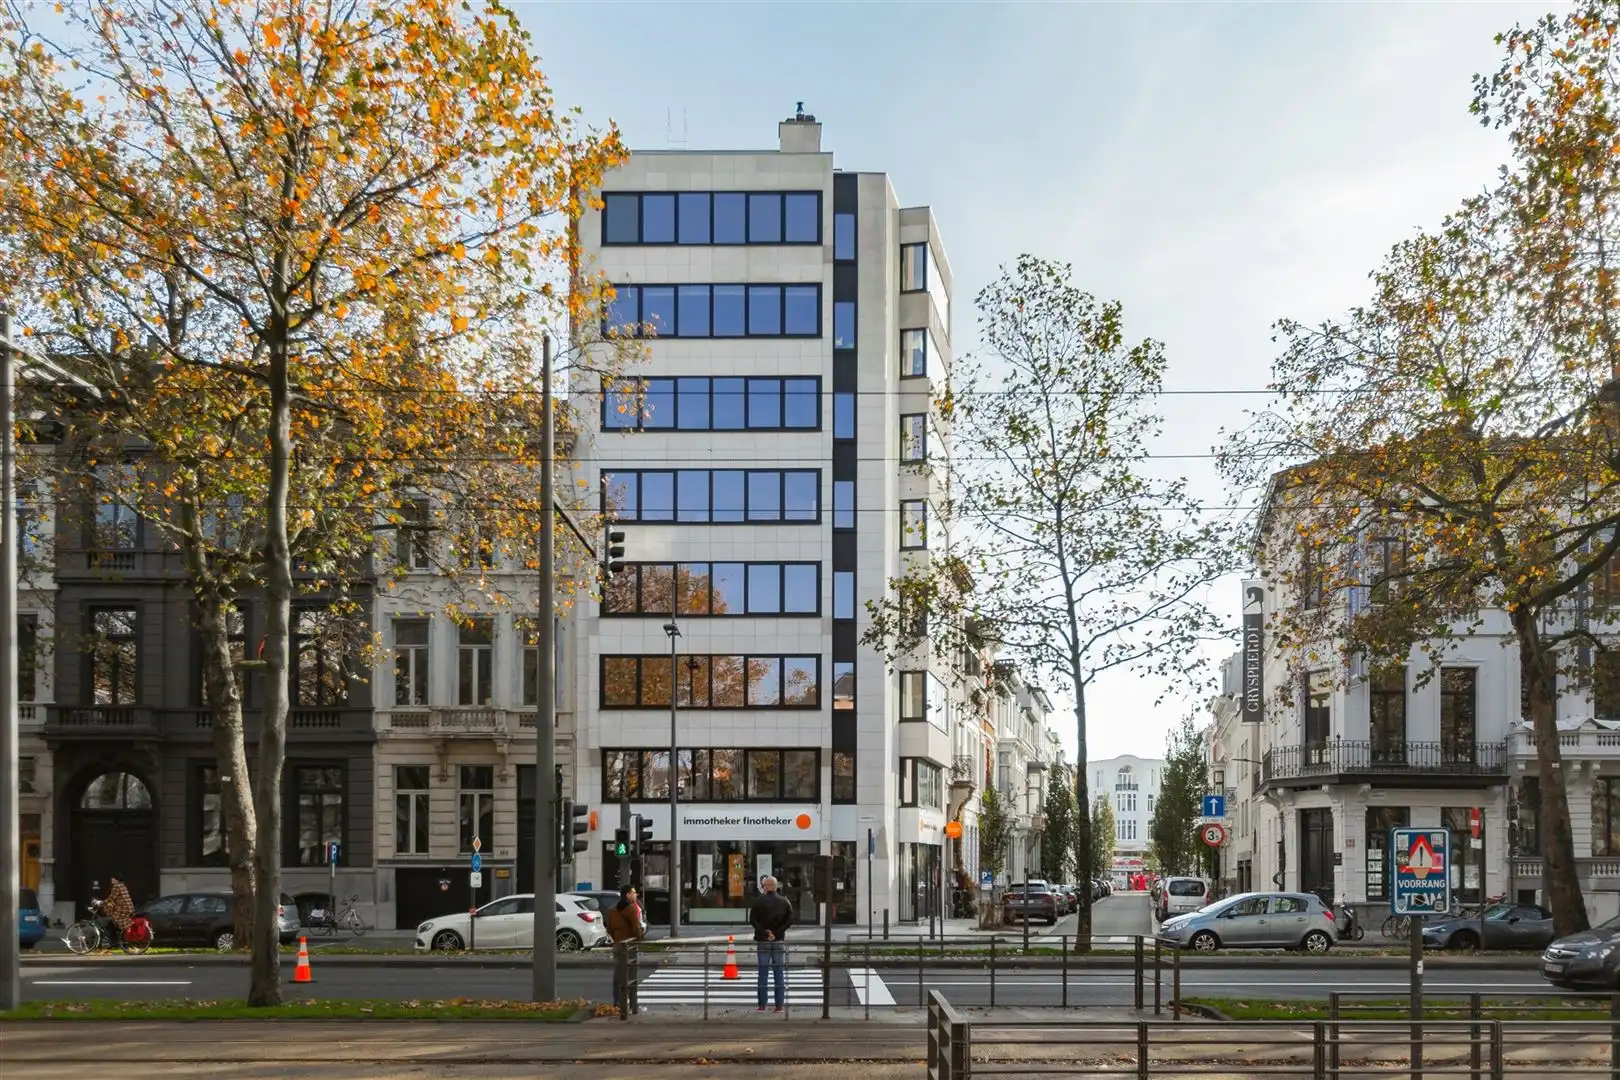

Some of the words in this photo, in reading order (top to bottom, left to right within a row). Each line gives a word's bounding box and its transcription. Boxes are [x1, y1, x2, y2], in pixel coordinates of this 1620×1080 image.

[683, 816, 740, 825] immotheker
[743, 816, 792, 825] finotheker
[1398, 879, 1446, 889] VOORRANG
